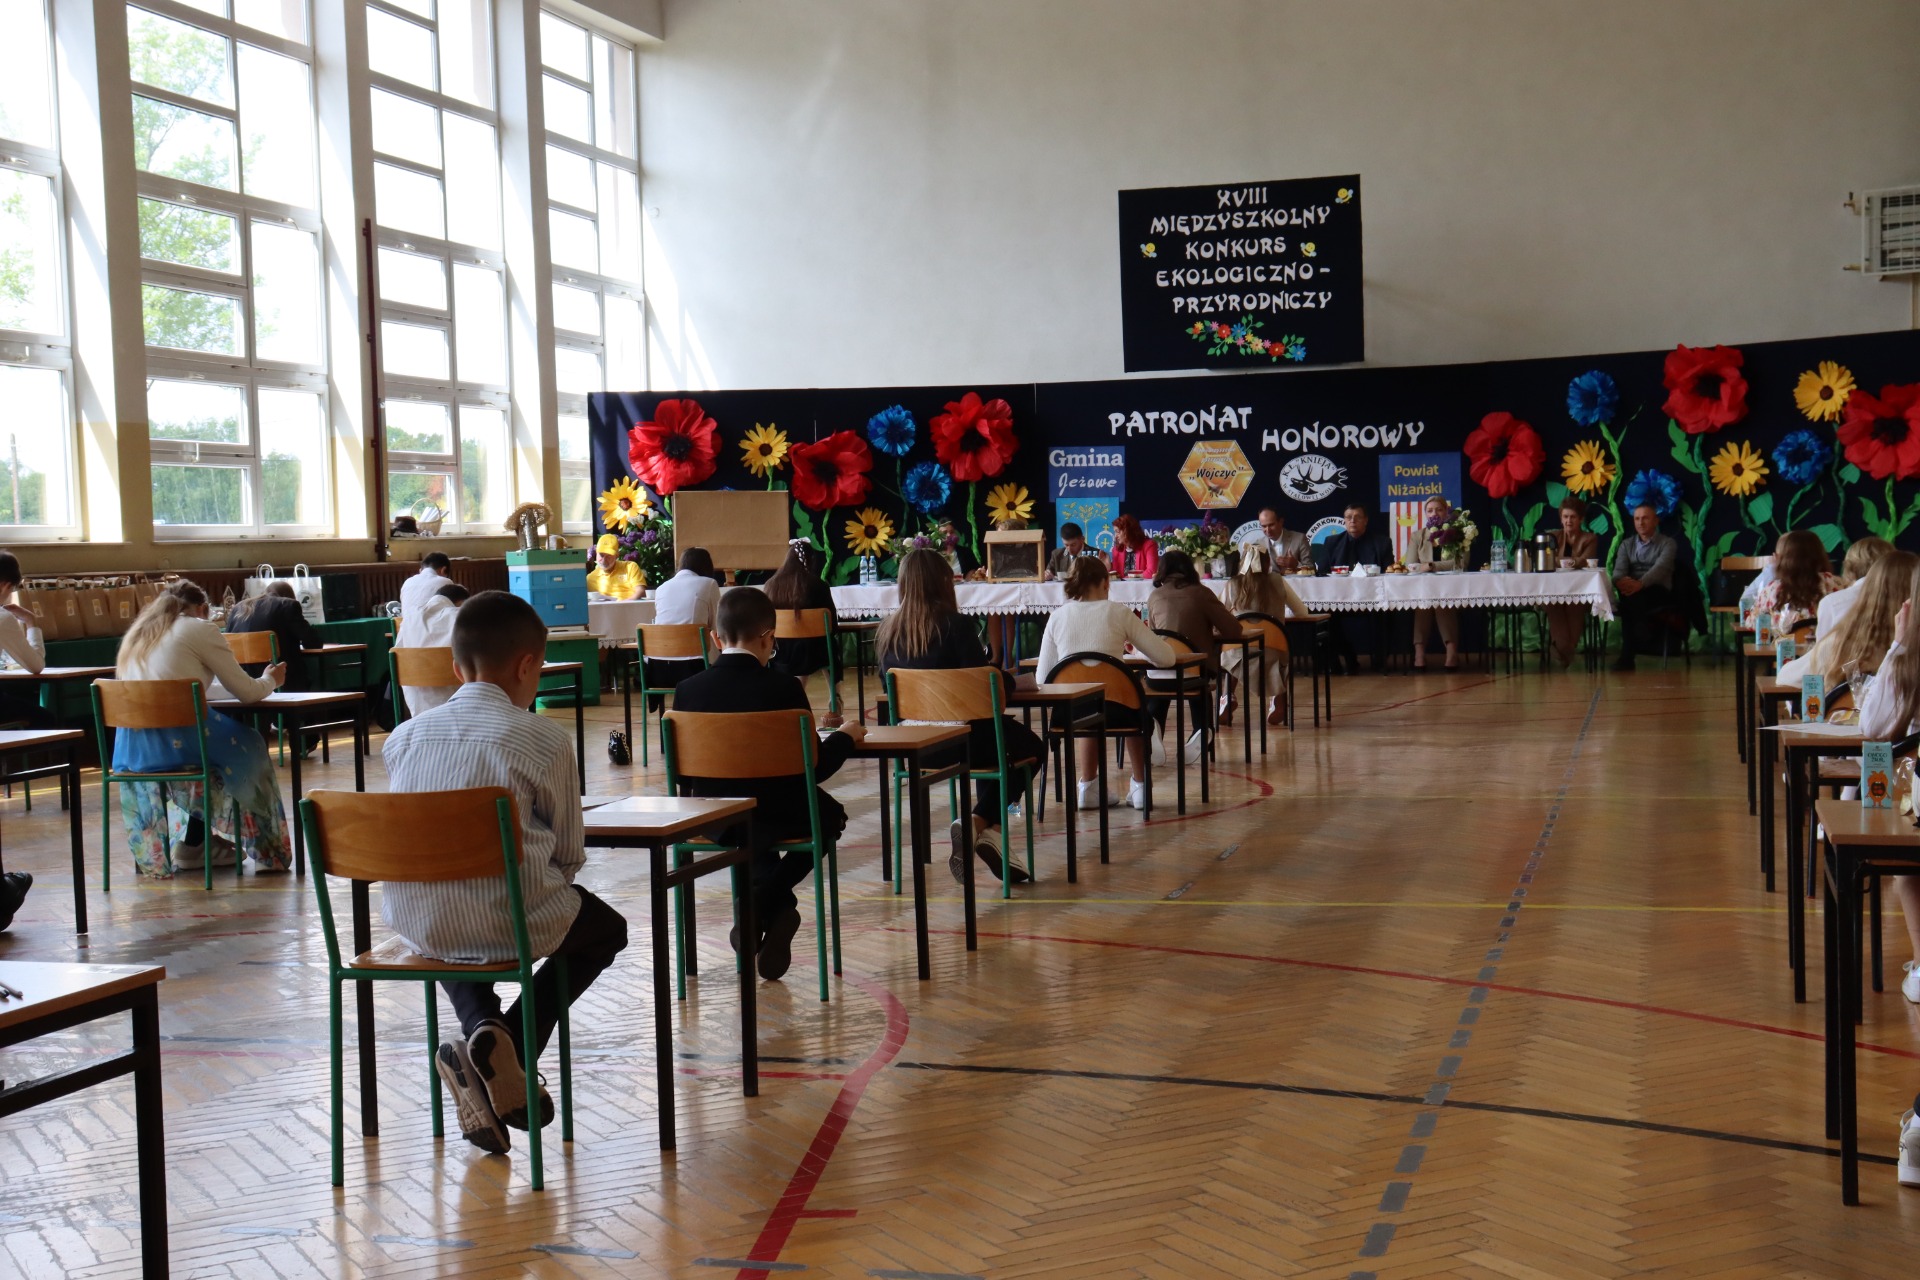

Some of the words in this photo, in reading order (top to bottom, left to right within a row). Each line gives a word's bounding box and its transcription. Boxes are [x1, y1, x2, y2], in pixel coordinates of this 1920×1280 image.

[1217, 187, 1268, 209] XVIII
[1150, 205, 1331, 237] MIĘDZYSZKOLNY
[1185, 236, 1287, 261] KONKURS
[1172, 290, 1333, 314] PRZYRODNICZY
[1108, 404, 1253, 437] PATRONAT
[1261, 421, 1425, 452] HONOROWY
[1048, 447, 1125, 467] Gmina
[1394, 464, 1439, 477] Powiat
[1058, 472, 1118, 497] Jeżowe
[1387, 482, 1443, 497] Niżański
